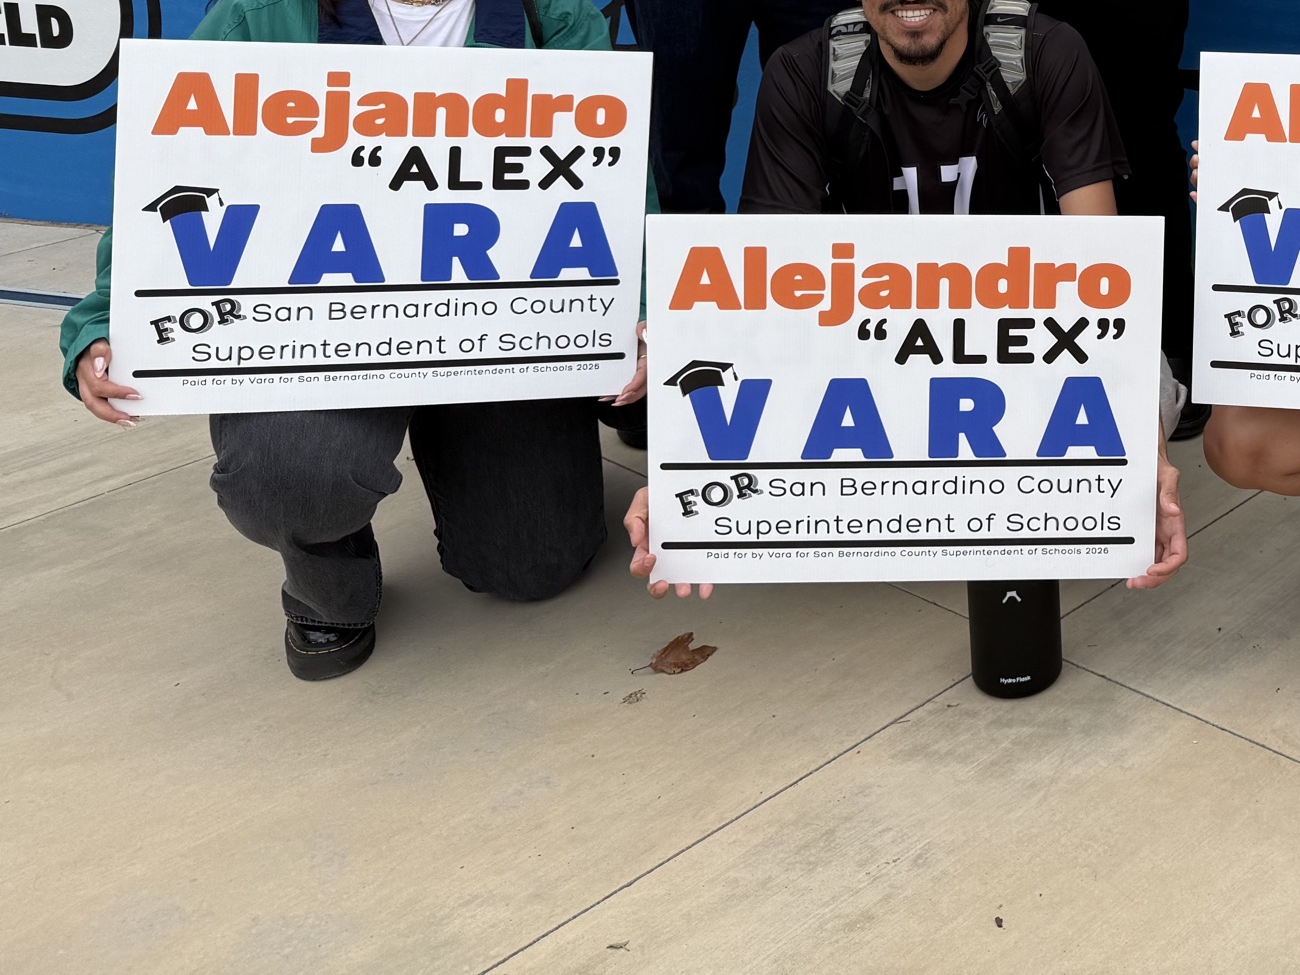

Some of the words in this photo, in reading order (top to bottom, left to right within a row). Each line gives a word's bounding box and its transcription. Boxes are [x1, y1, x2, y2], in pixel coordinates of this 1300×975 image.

[0, 1, 74, 50] LD
[151, 72, 626, 153] Alejandro
[351, 145, 620, 191] “ALEX”
[169, 202, 618, 287] VARA
[669, 243, 1131, 327] Alejandro
[149, 298, 247, 346] FOR
[252, 303, 313, 323] San
[328, 297, 498, 320] Bernardino
[510, 294, 614, 317] County
[858, 317, 1126, 365] “ALEX”
[192, 335, 447, 366] Superintendent
[459, 333, 489, 353] of
[498, 330, 612, 352] Schools
[182, 378, 208, 387] Paid
[212, 378, 227, 386] for
[231, 378, 245, 386] by
[279, 375, 294, 383] for
[324, 373, 386, 382] Bernardino
[389, 371, 428, 379] County
[432, 367, 515, 378] Superintendent
[519, 366, 530, 374] of
[533, 365, 573, 373] Schools
[576, 364, 600, 372] 2026
[1250, 371, 1271, 380] Paid
[1274, 373, 1287, 381] for
[1290, 374, 1300, 383] by
[689, 377, 1126, 461] VARA
[675, 472, 764, 518] FOR
[769, 478, 826, 497] San
[840, 475, 1005, 496] Bernardino
[1017, 474, 1123, 499] County
[714, 514, 955, 540] Superintendent
[967, 513, 997, 533] of
[1006, 512, 1121, 532] Schools
[707, 551, 730, 559] Paid
[733, 551, 748, 559] for
[751, 552, 764, 560] by
[767, 551, 792, 559] Vara
[796, 551, 810, 559] for
[838, 550, 897, 558] Bernardino
[900, 549, 938, 558] County
[941, 548, 1024, 558] Superintendent
[1027, 548, 1038, 556] of
[1085, 547, 1109, 555] 2026
